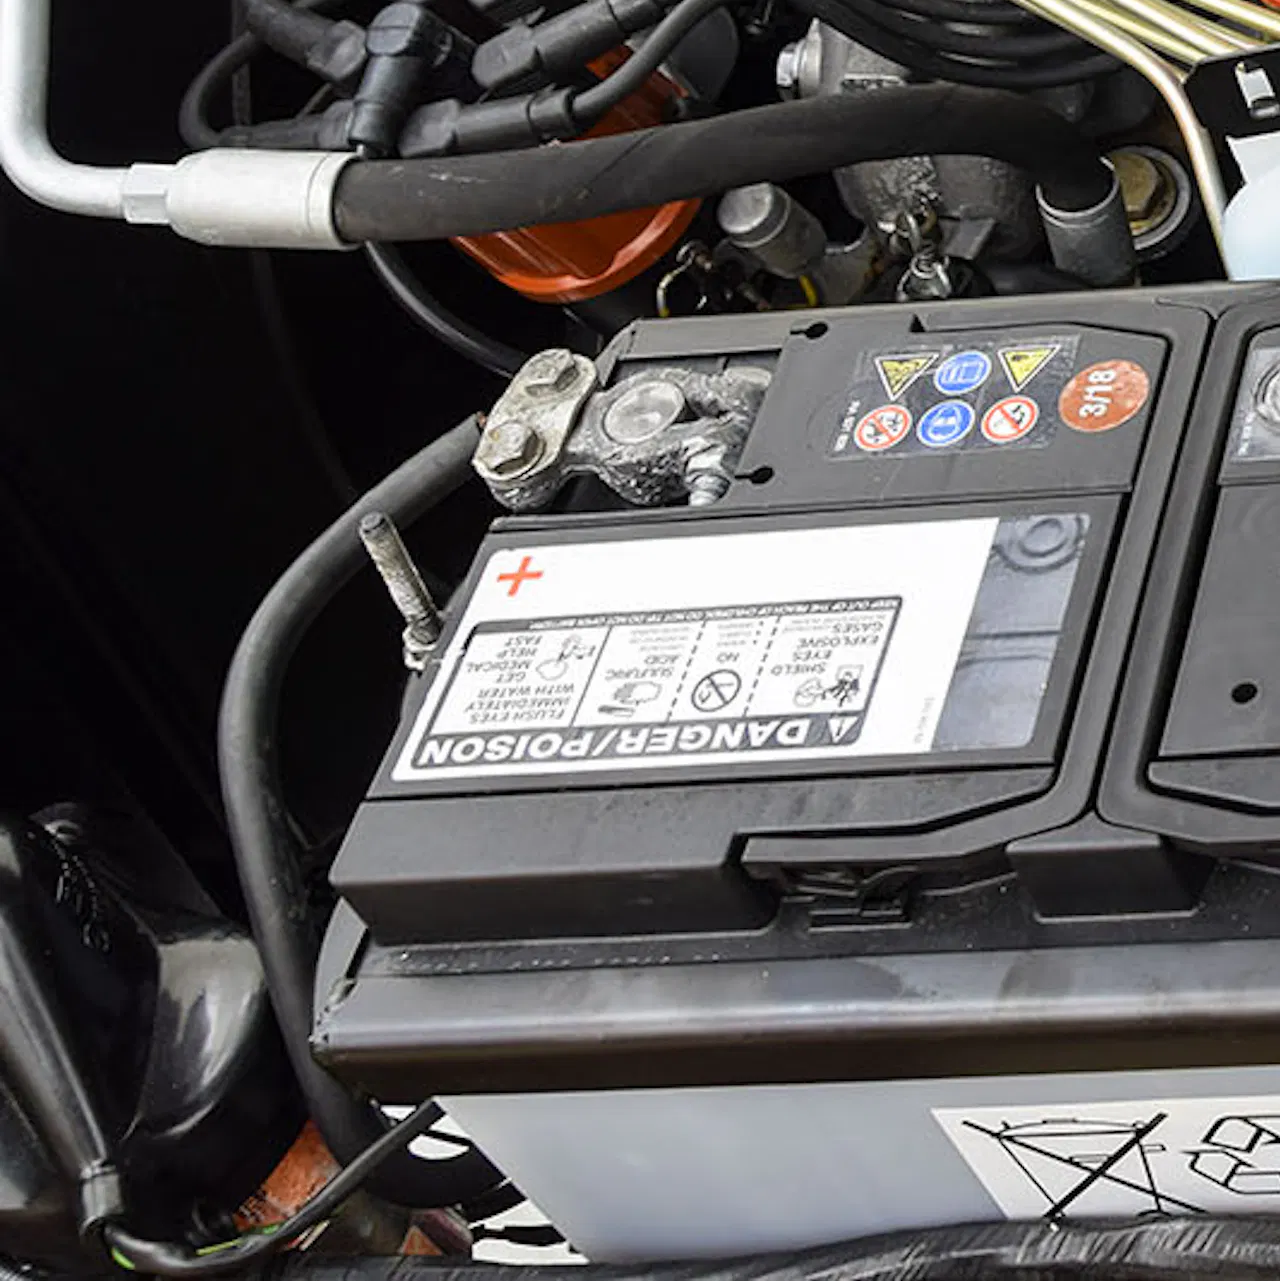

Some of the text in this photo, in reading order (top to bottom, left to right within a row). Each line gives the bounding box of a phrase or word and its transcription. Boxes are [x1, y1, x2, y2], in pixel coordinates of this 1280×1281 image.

[832, 621, 884, 634] GASES
[504, 635, 544, 647] FAST
[797, 634, 880, 649] EXPLOSIVE
[496, 648, 539, 659] HELP
[643, 654, 681, 666] ACID
[716, 651, 740, 664] NO
[792, 649, 833, 662] EYES
[465, 660, 533, 673] MEDICAL
[770, 662, 827, 677] SHIELD
[496, 672, 527, 684] GET
[604, 667, 675, 681] SULFURIC
[477, 683, 575, 699] WITH WATER
[463, 697, 571, 713] IMMEDIATELY
[468, 708, 565, 724] FLUSH EYES
[418, 719, 811, 766] DANGER/POISON
